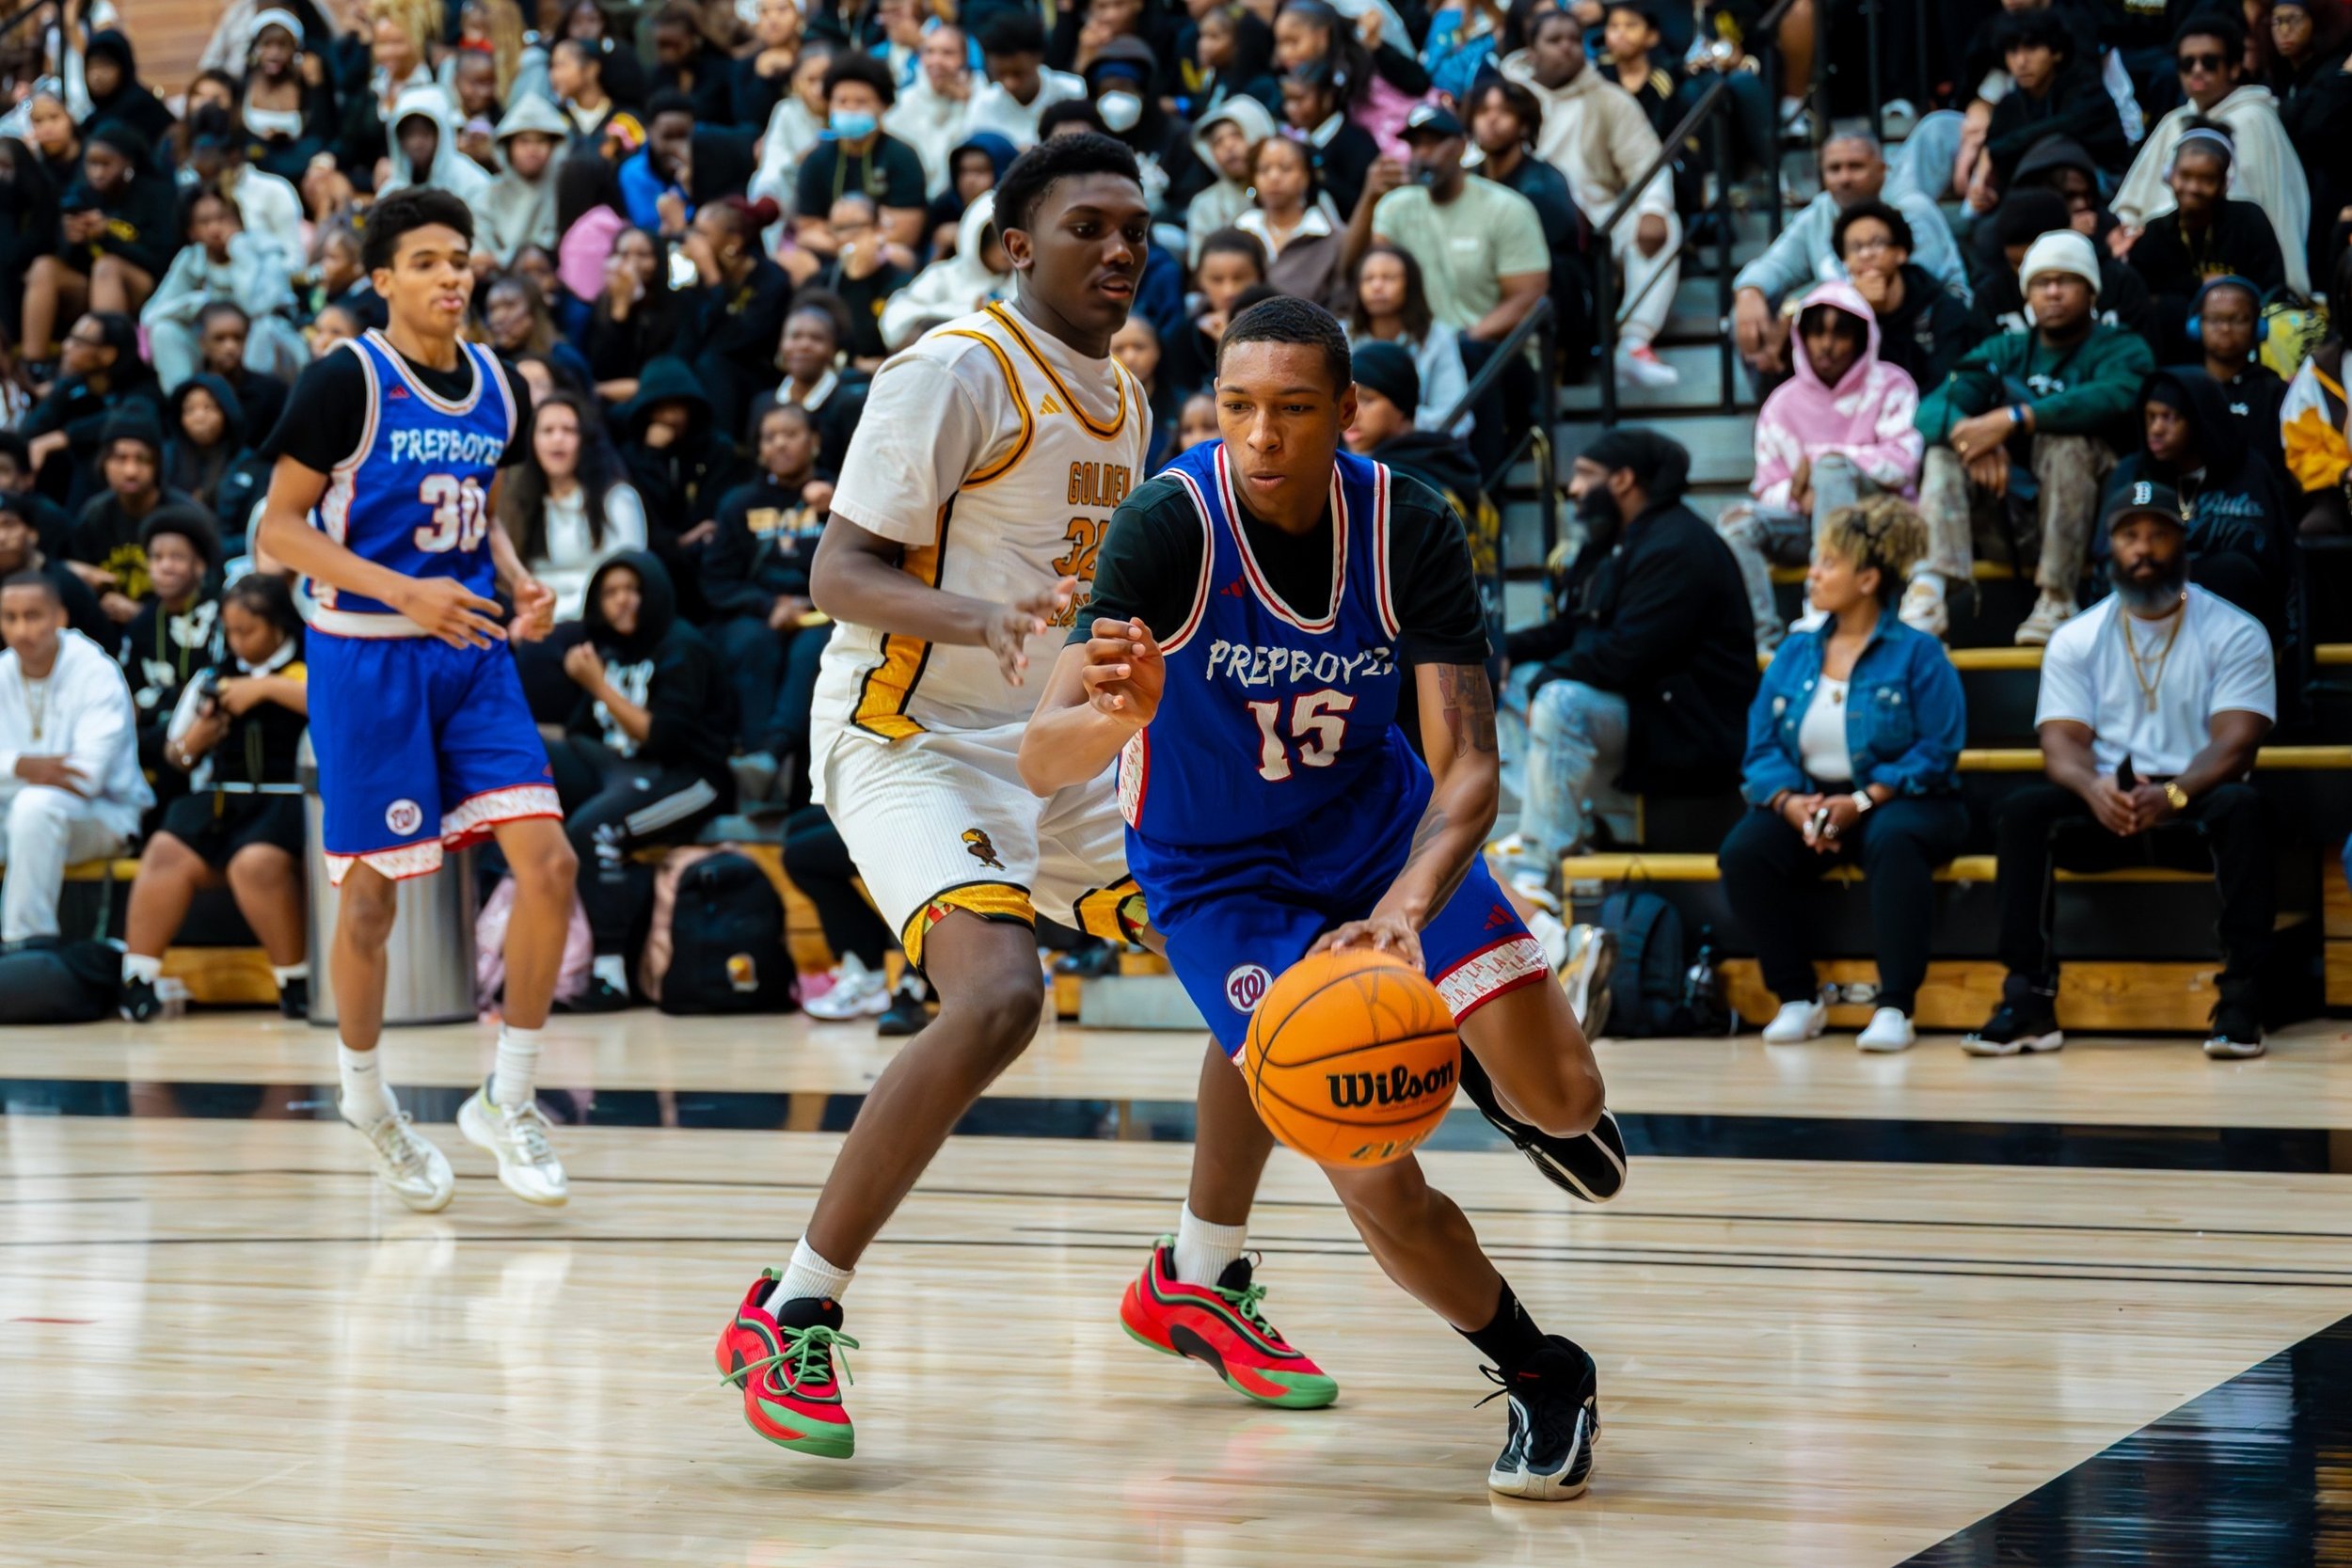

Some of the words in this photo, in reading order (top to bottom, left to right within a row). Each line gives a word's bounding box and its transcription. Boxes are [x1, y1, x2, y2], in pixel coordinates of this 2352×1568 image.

[414, 473, 487, 554] 30
[1247, 689, 1357, 782] 15
[1326, 1061, 1454, 1108] Wilson
